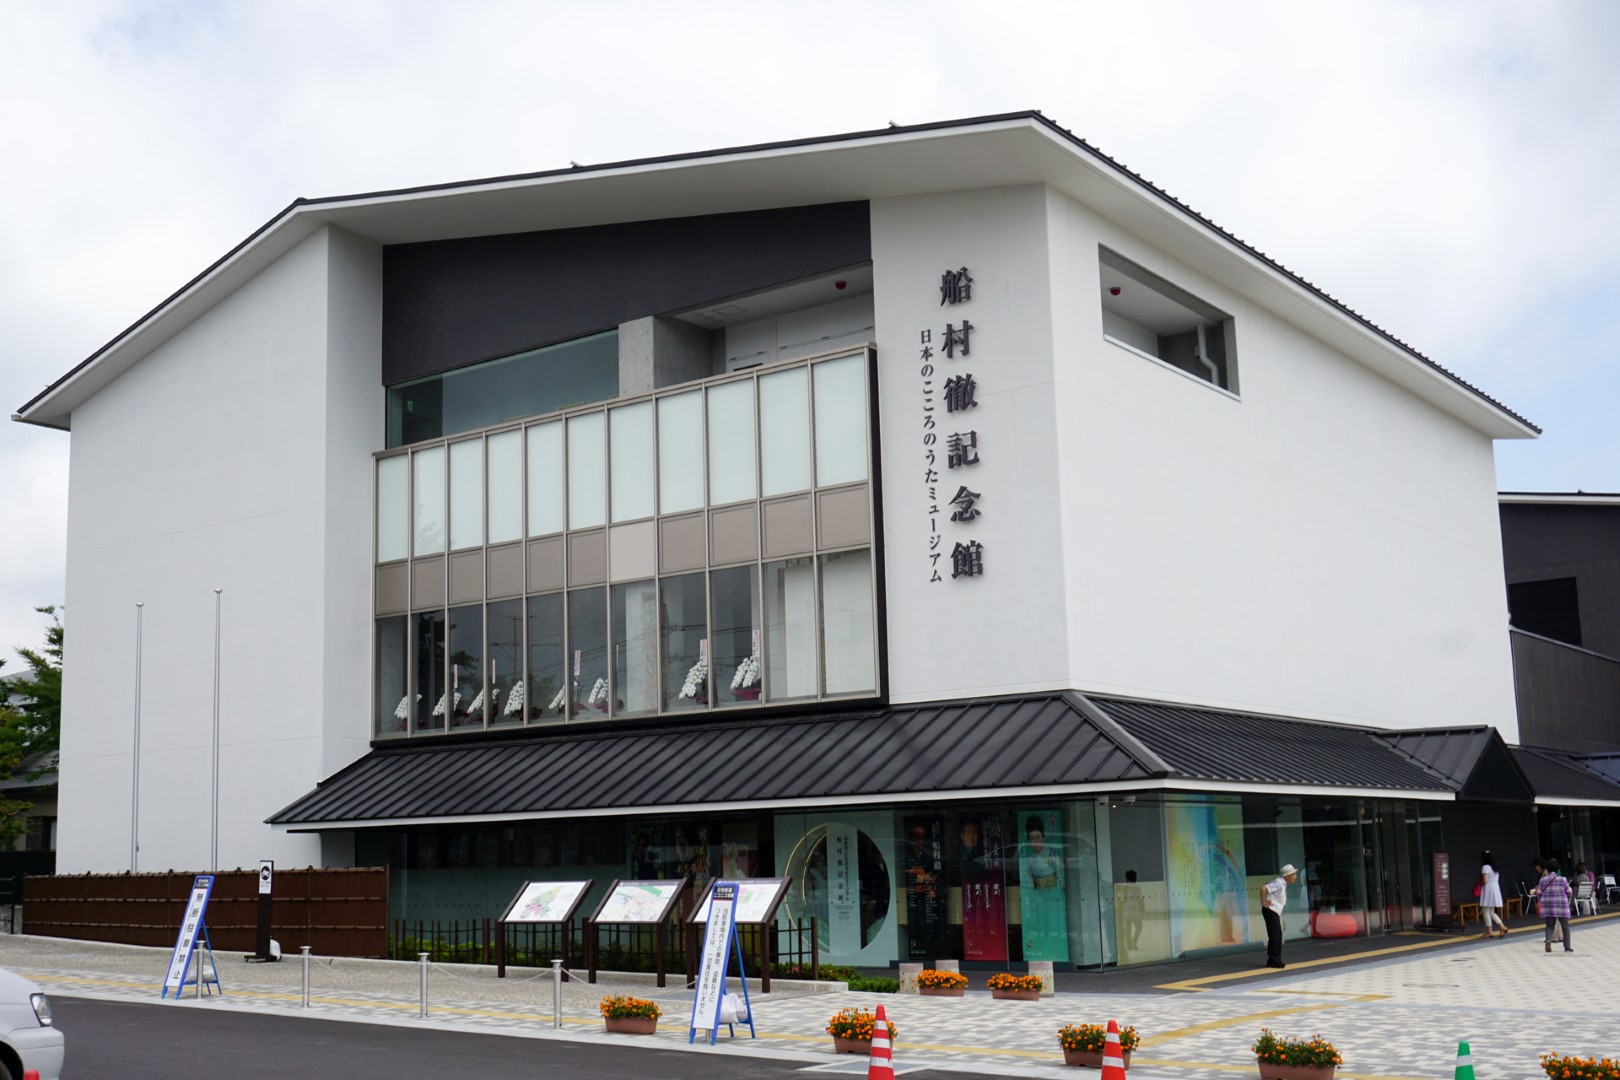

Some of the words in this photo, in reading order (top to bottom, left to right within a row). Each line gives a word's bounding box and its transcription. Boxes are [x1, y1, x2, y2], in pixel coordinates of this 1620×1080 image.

[920, 328, 942, 583] 日本のこころのうたミュージアム
[939, 266, 984, 580] 船村徹記念館
